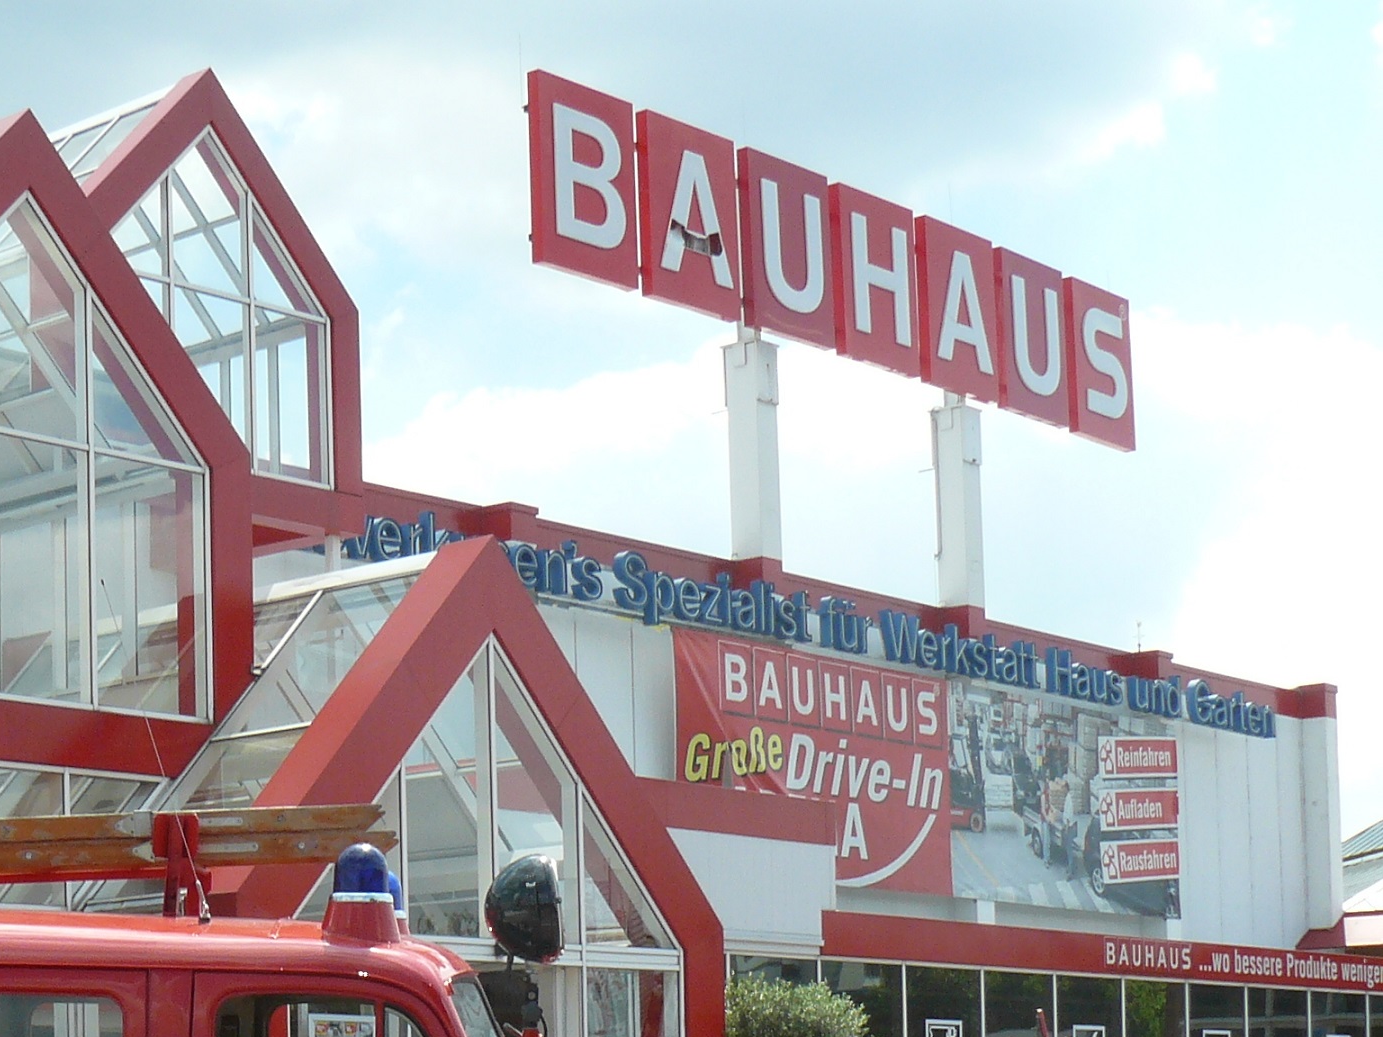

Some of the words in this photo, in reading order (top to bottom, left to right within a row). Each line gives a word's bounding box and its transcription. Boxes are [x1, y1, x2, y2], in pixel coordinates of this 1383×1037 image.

[552, 102, 1129, 420] BAUHAUS
[612, 550, 813, 642] Spezialist
[818, 594, 873, 654] für
[878, 608, 1041, 689] Werkstatt
[1045, 646, 1124, 706] Haus
[1126, 675, 1182, 719] und
[1186, 678, 1276, 738] Garten
[724, 653, 938, 736] BAUHAUS
[684, 726, 783, 782] Große
[786, 732, 943, 811] Drive-In
[1117, 746, 1171, 768] Reinfahren
[1118, 798, 1162, 820] Aufladen
[1120, 849, 1177, 873] Rausfahren
[1106, 942, 1192, 970] BAUHAUS
[1235, 949, 1282, 977] bessere
[1286, 953, 1338, 981] Produkte
